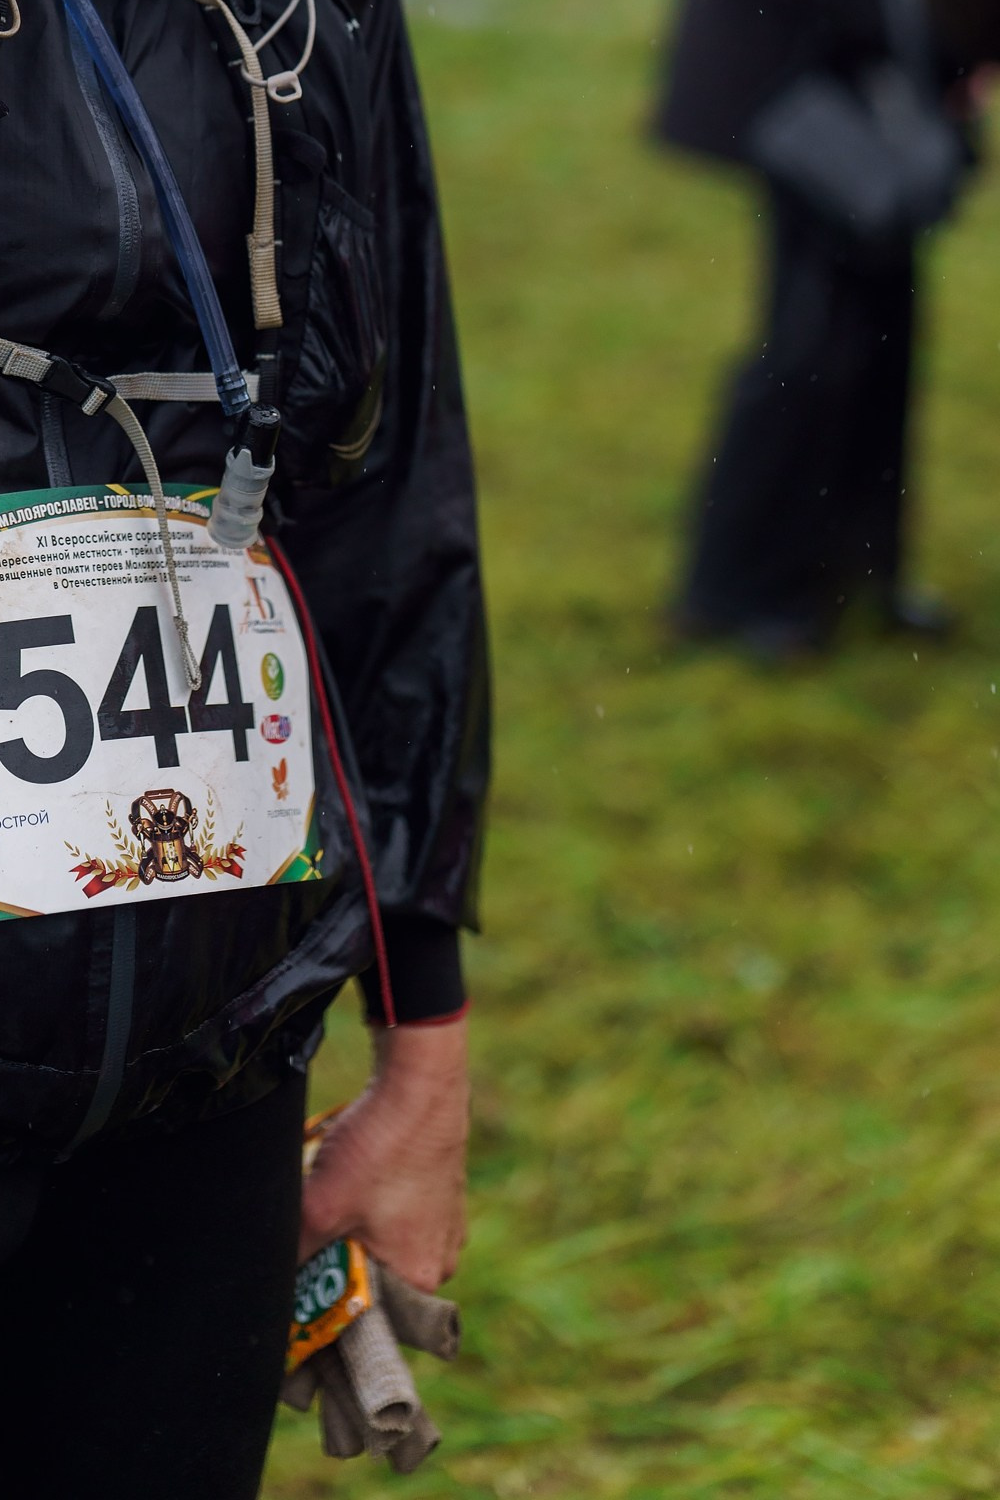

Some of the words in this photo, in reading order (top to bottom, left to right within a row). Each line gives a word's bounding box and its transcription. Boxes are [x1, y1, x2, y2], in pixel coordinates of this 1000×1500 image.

[104, 494, 137, 510] ГОРОД
[51, 530, 133, 547] Всероссийские
[73, 547, 122, 560] местности
[56, 564, 90, 575] памяти
[93, 561, 124, 574] героев
[53, 581, 59, 590] в
[62, 573, 132, 590] Отечественной
[135, 573, 157, 584] войне
